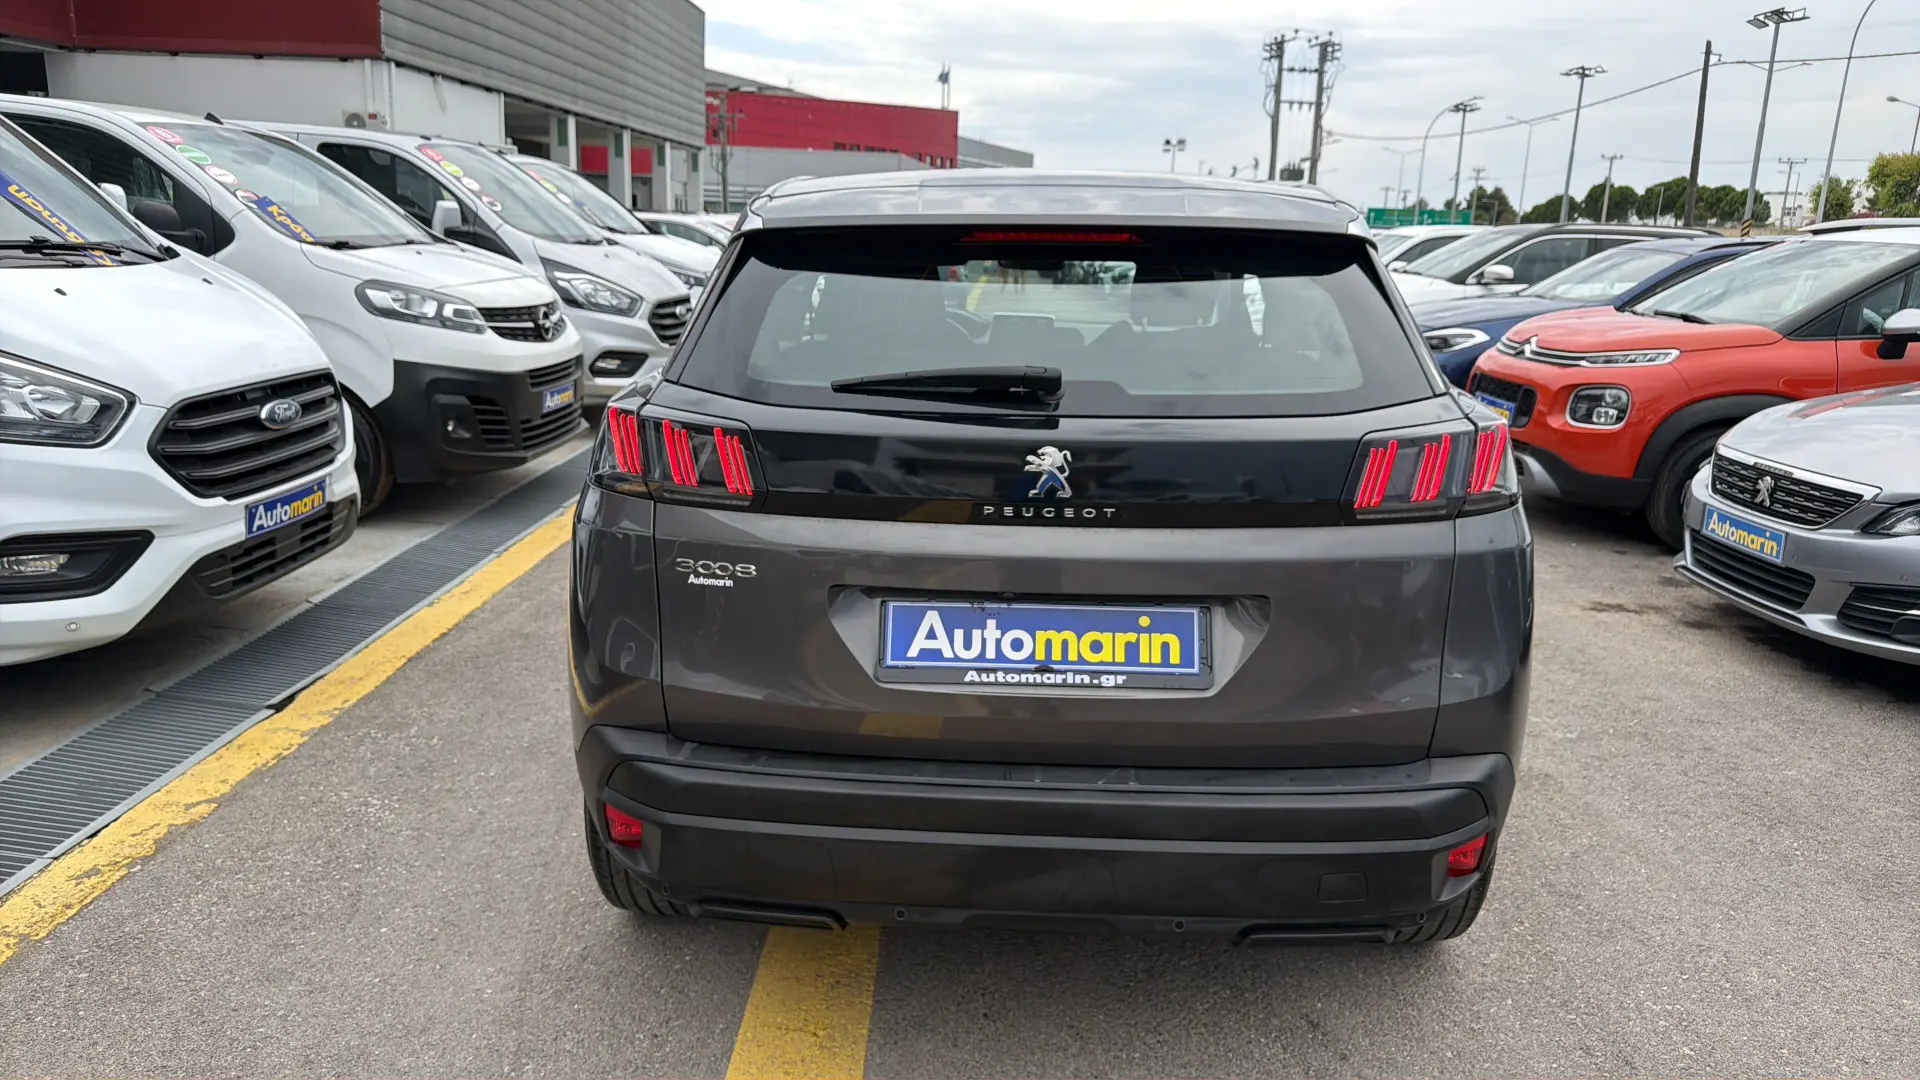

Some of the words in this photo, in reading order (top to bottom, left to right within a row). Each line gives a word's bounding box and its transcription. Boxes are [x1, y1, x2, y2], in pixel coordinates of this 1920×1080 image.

[251, 484, 324, 532] Automarin
[983, 506, 1116, 518] PEUGEOT
[1707, 511, 1778, 557] Automarin
[675, 557, 757, 577] 3008
[688, 573, 734, 587] Automarin
[906, 610, 1181, 665] Automarin
[963, 669, 1127, 687] Automarin.gr
